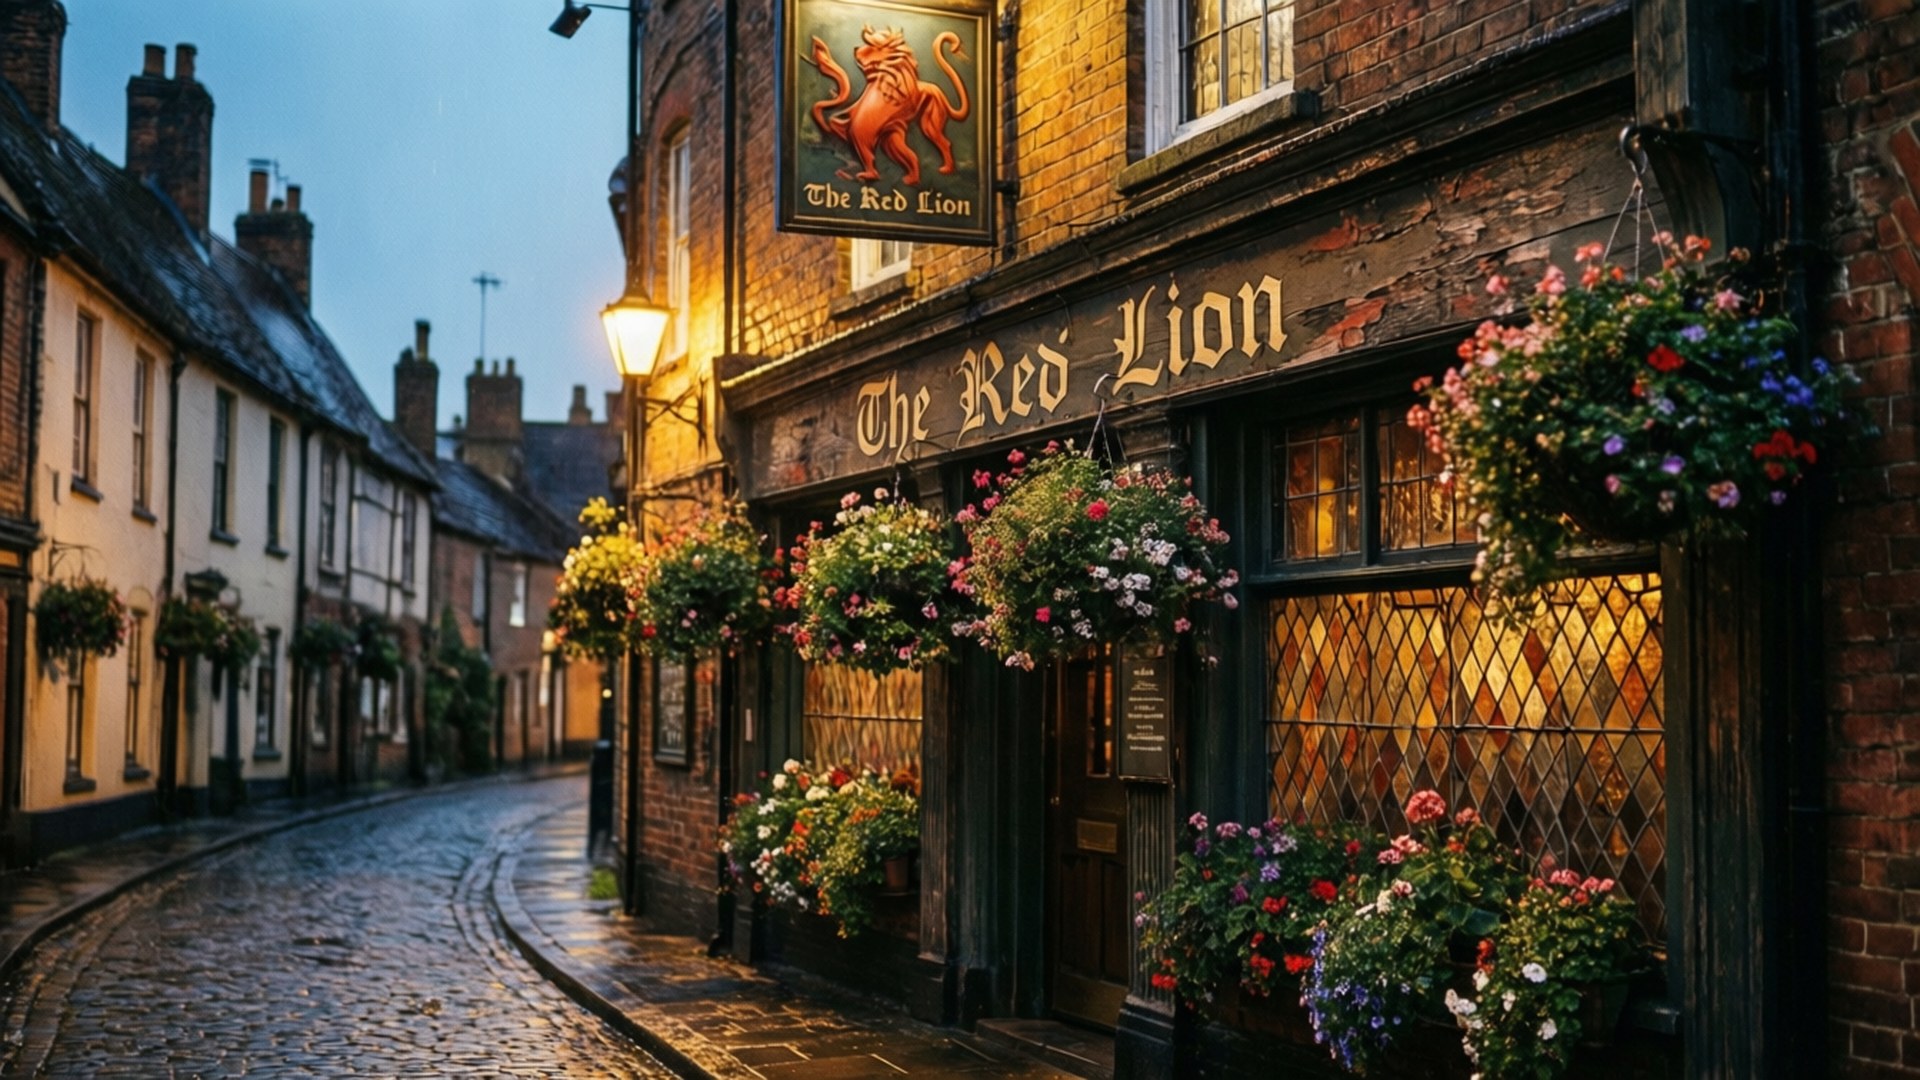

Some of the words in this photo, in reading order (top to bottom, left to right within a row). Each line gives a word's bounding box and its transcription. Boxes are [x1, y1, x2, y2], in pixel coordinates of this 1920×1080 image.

[803, 183, 851, 209] The
[859, 186, 908, 212] Red
[916, 189, 971, 216] Lion
[856, 373, 931, 463] The
[956, 327, 1069, 447] Red
[1112, 272, 1288, 396] Lion
